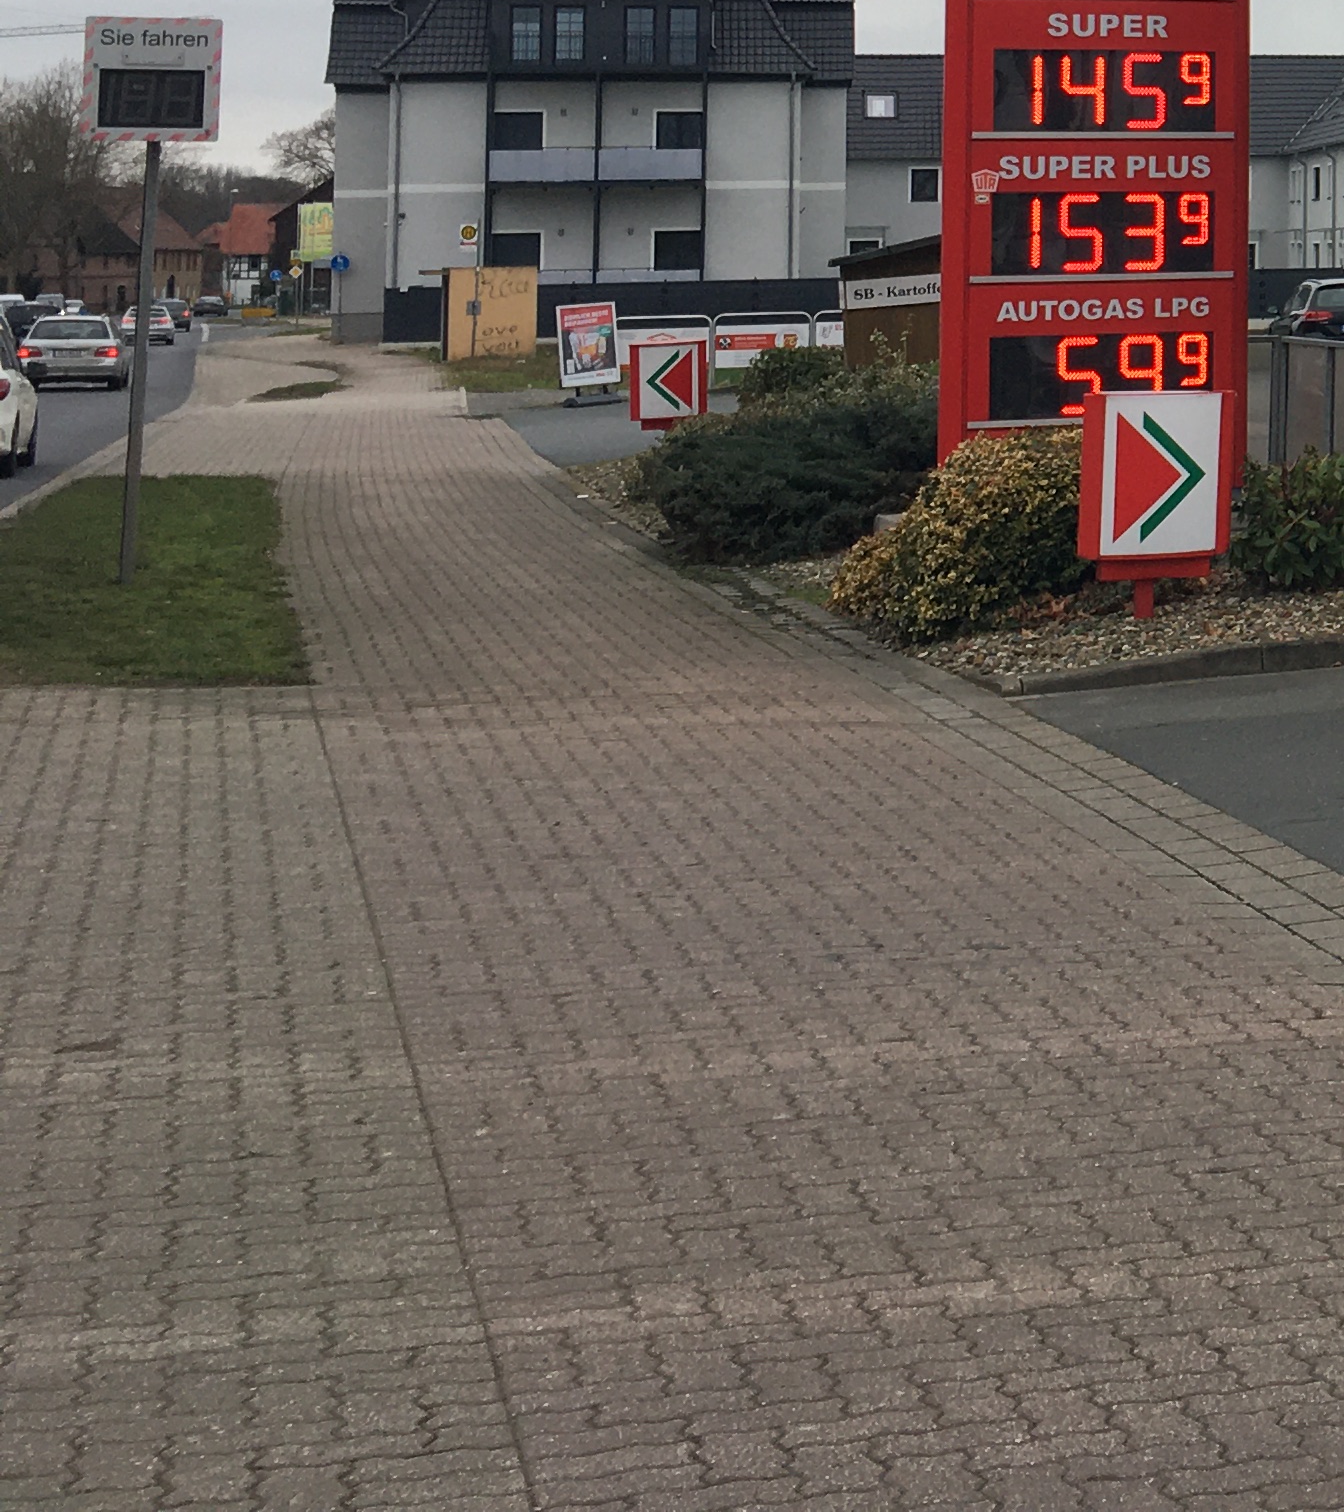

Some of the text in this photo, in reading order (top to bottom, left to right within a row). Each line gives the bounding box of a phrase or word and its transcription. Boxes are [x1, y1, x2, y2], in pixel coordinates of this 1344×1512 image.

[100, 28, 209, 48] Sie fahren
[1047, 12, 1169, 38] SUPER
[1000, 154, 1211, 180] SUPER PLUS
[853, 288, 875, 301] SB
[997, 296, 1210, 322] AUTOGAS LPG
